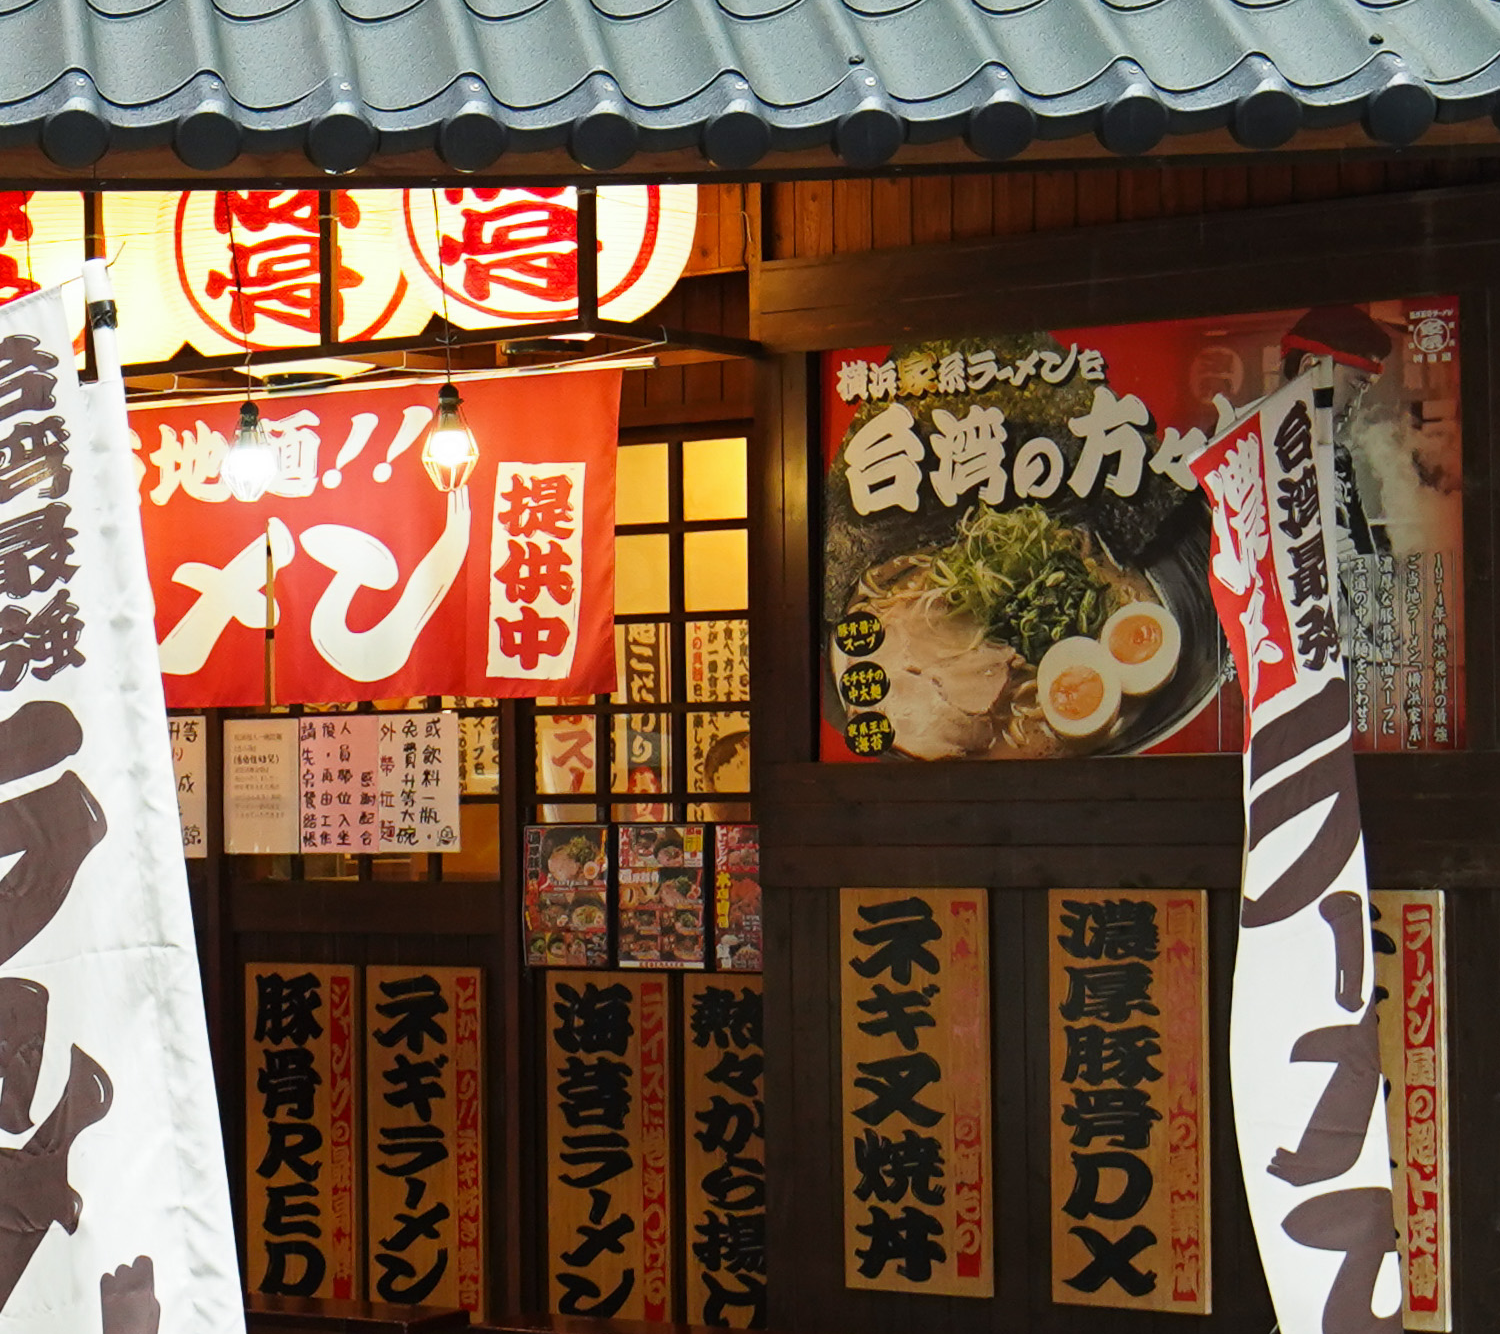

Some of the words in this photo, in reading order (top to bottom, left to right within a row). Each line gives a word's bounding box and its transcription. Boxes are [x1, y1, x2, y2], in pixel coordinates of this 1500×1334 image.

[836, 343, 1108, 404] 横浜家系ラーメンを
[493, 473, 575, 670] 提供中
[842, 668, 884, 686] モチモチの
[843, 633, 876, 652] スープ
[252, 971, 328, 1296] 豚骨RED
[373, 973, 452, 1305] ネギラーメン
[552, 982, 637, 1319] 海苔ラーメン
[1057, 897, 1164, 1298] 濃厚豚骨DX
